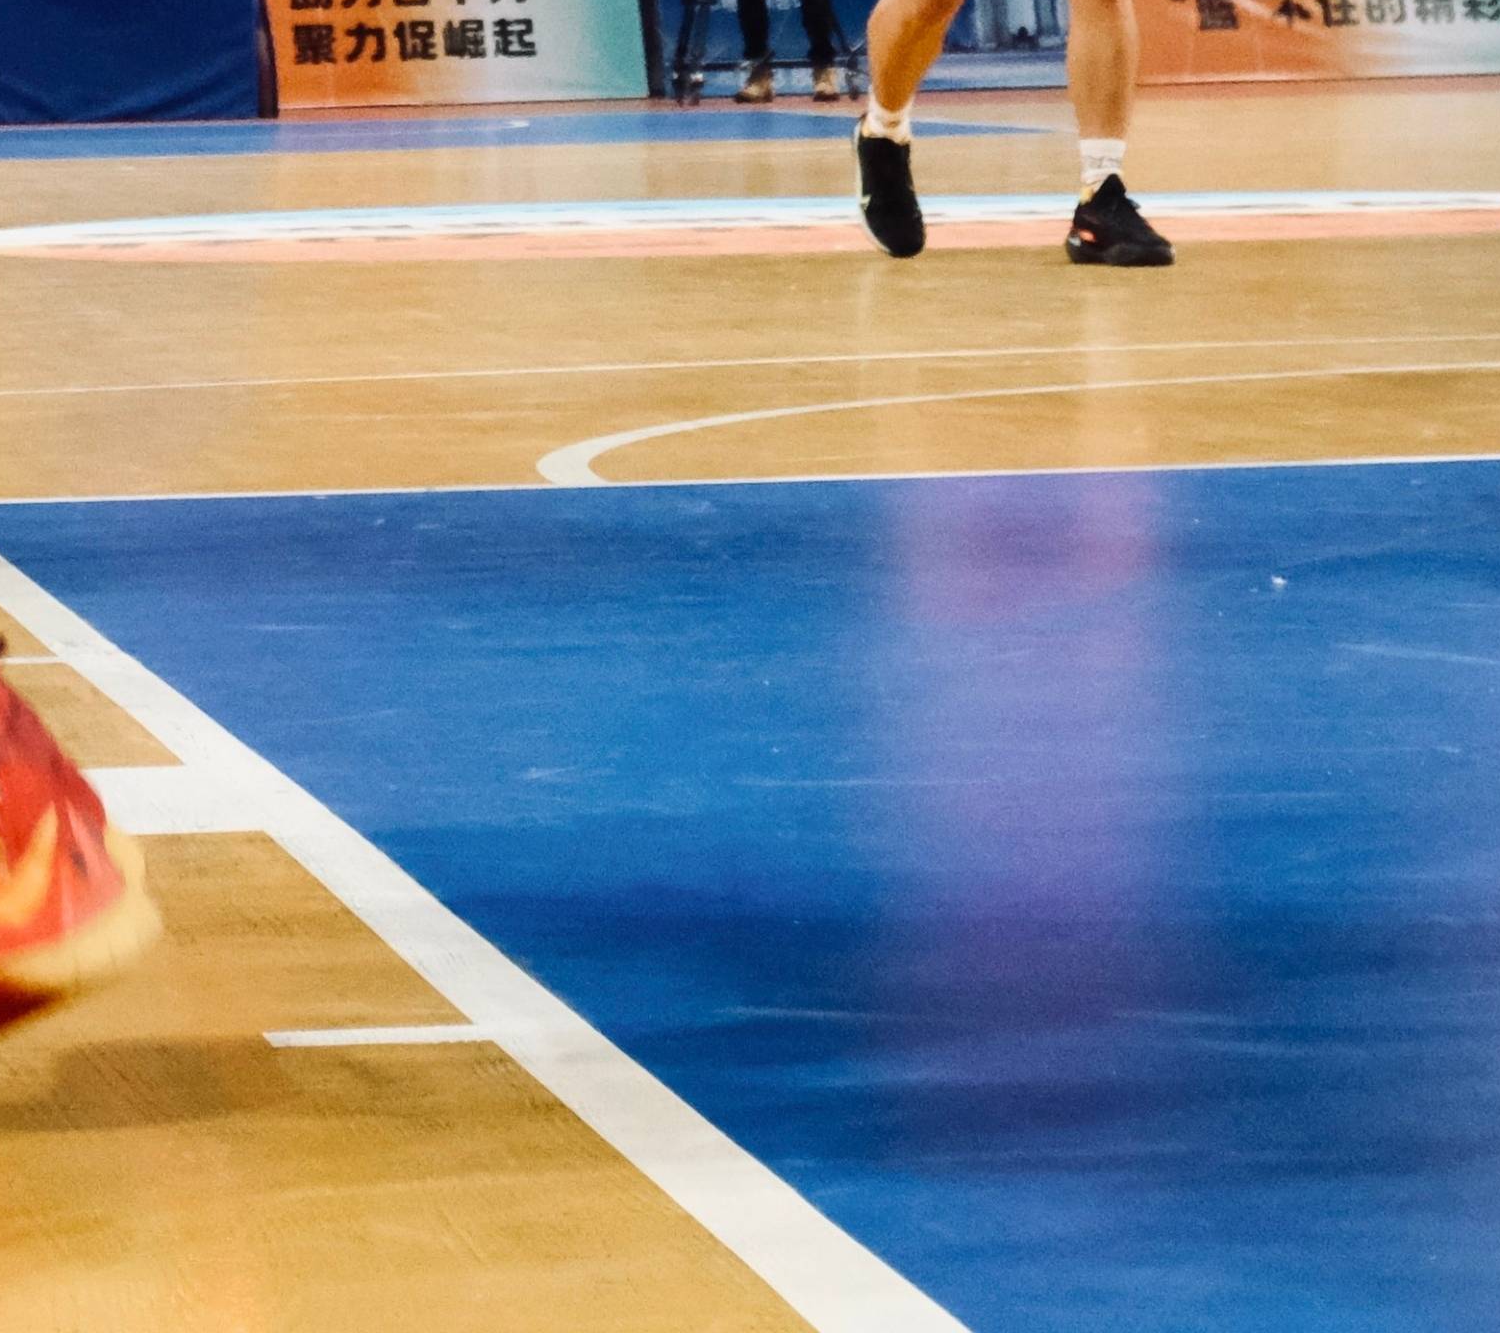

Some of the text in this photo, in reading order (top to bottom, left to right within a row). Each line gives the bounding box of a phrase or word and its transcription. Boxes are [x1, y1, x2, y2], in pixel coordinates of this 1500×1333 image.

[293, 18, 537, 65] 聚力促崛起
